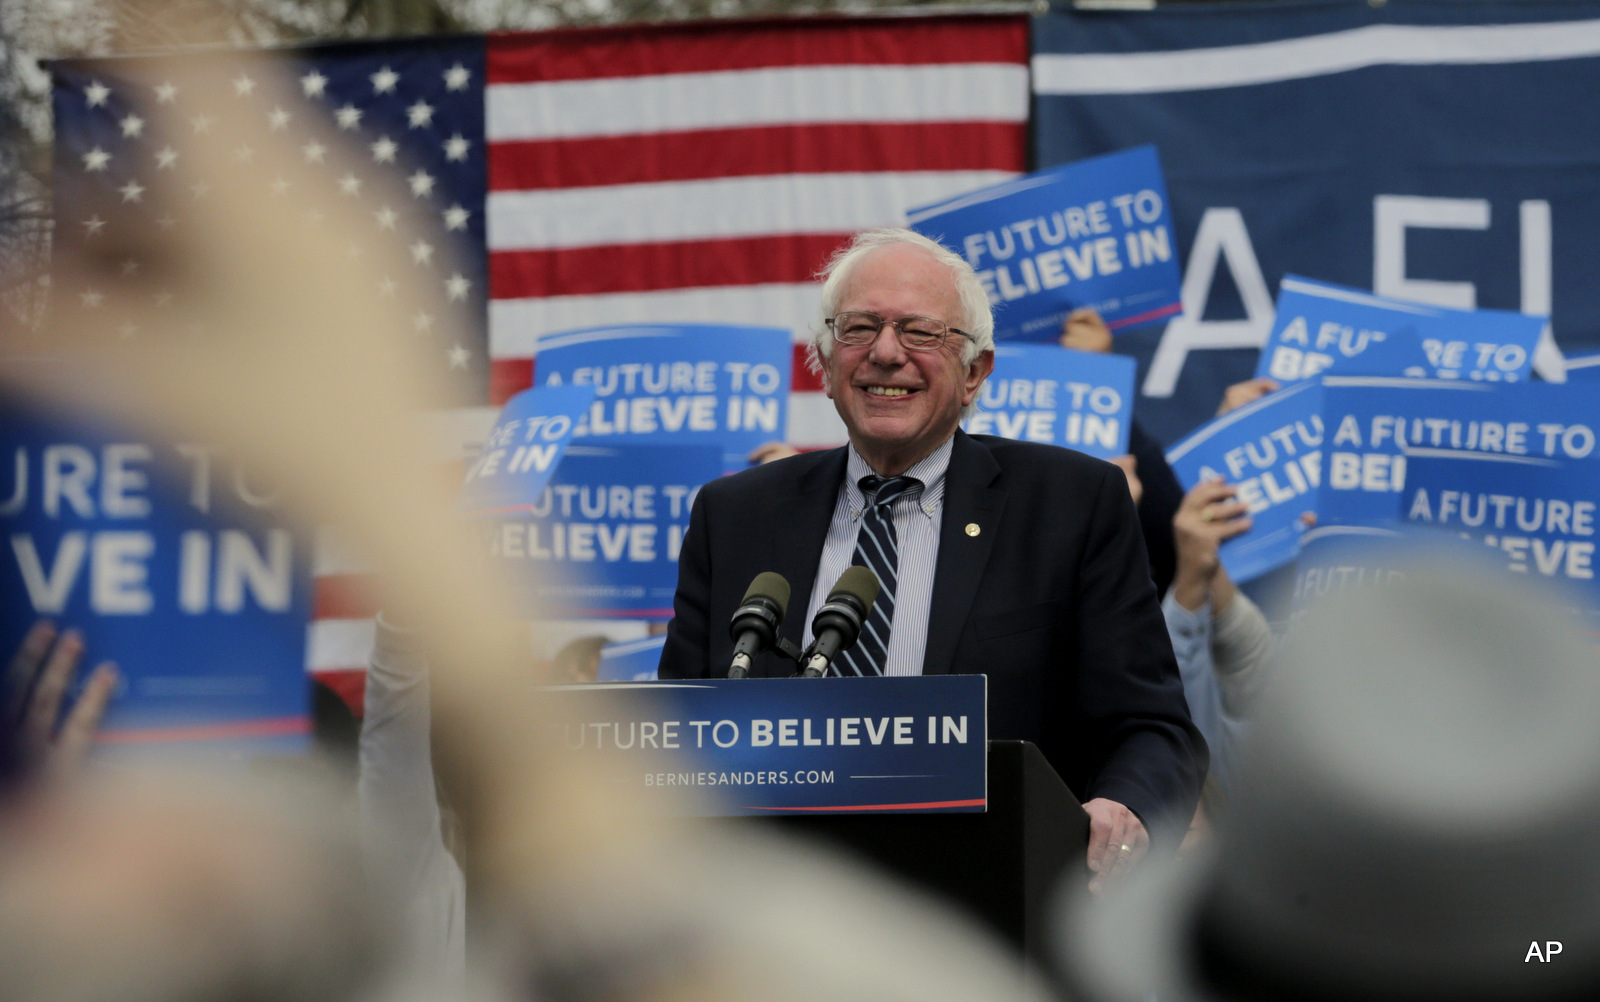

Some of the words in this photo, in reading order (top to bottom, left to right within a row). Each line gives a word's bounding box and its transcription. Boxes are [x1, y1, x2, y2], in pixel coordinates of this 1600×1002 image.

[963, 200, 1111, 265] FUTURE
[1112, 189, 1163, 228] TO
[1125, 224, 1172, 269] IN
[1141, 206, 1279, 397] A
[1280, 315, 1309, 347] A
[1474, 342, 1527, 372] TO
[572, 361, 719, 397] FUTURE
[724, 362, 781, 395] TO
[1065, 381, 1122, 415] TO
[524, 414, 571, 443] TO
[727, 397, 779, 432] IN
[1065, 412, 1120, 449] IN
[1225, 414, 1325, 479] FUTU
[1333, 414, 1362, 448] A
[1370, 414, 1530, 455] FUTURE
[1536, 423, 1597, 459] TO
[507, 443, 558, 474] IN
[1408, 488, 1434, 522] A
[1438, 490, 1597, 536] FUTURE
[178, 527, 293, 616] IN
[689, 719, 739, 746] TO
[750, 716, 914, 747] BELIEVE
[928, 715, 968, 744] IN
[644, 770, 835, 787] BERNIESANDERS.COM
